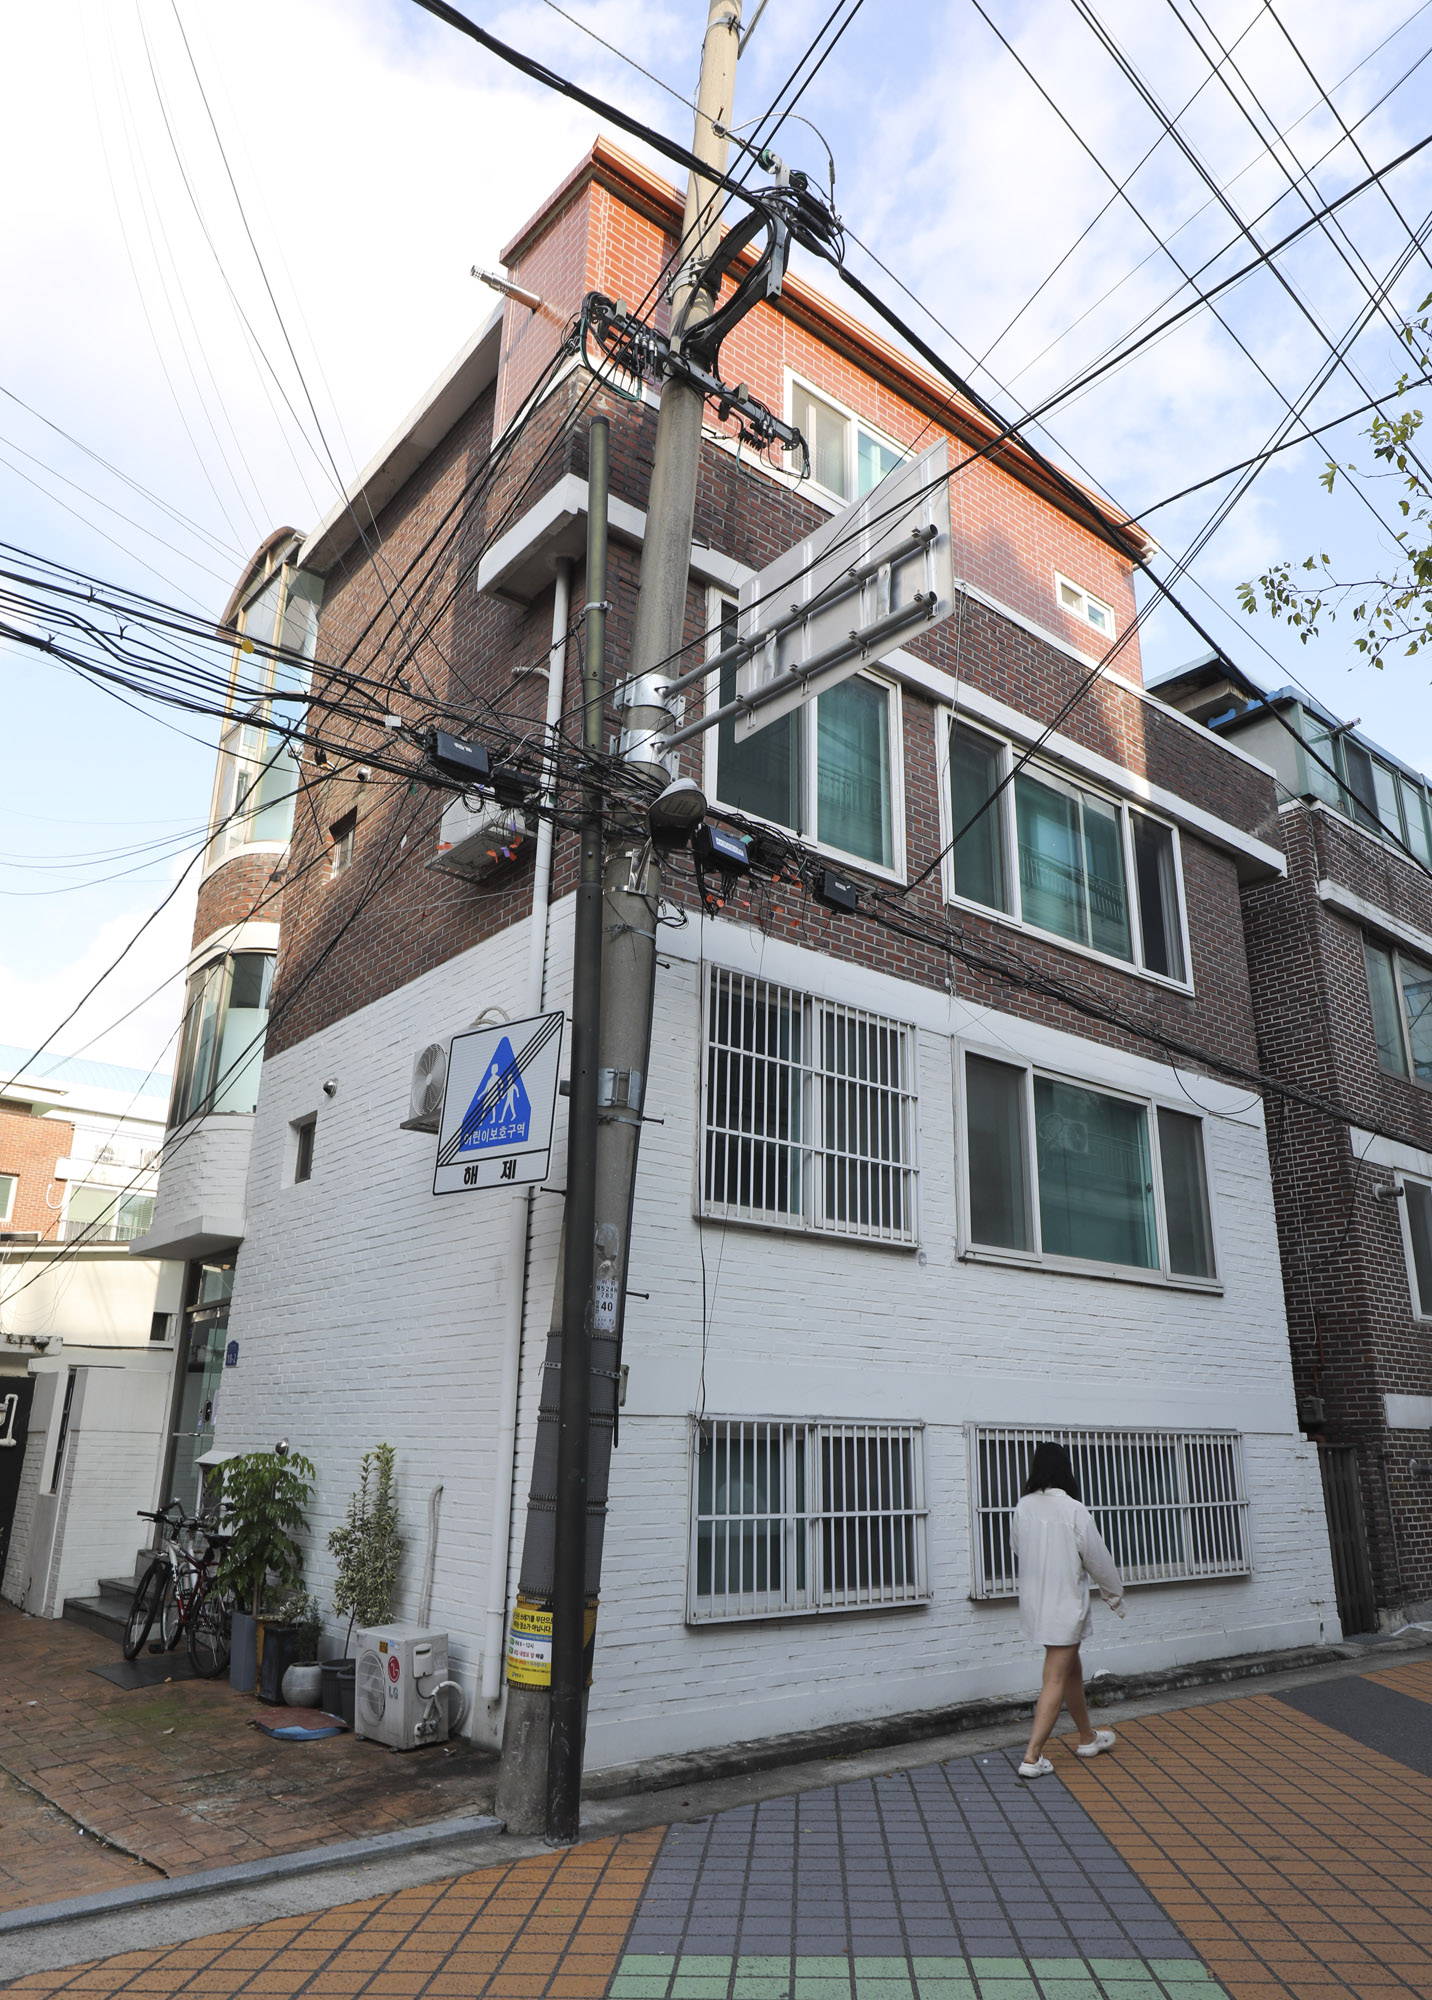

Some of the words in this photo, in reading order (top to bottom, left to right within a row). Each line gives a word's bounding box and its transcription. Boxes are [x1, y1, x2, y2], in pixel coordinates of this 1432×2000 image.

[463, 1122, 525, 1145] 어린이보호구역
[600, 1301, 613, 1312] 40
[389, 1686, 399, 1700] LG
